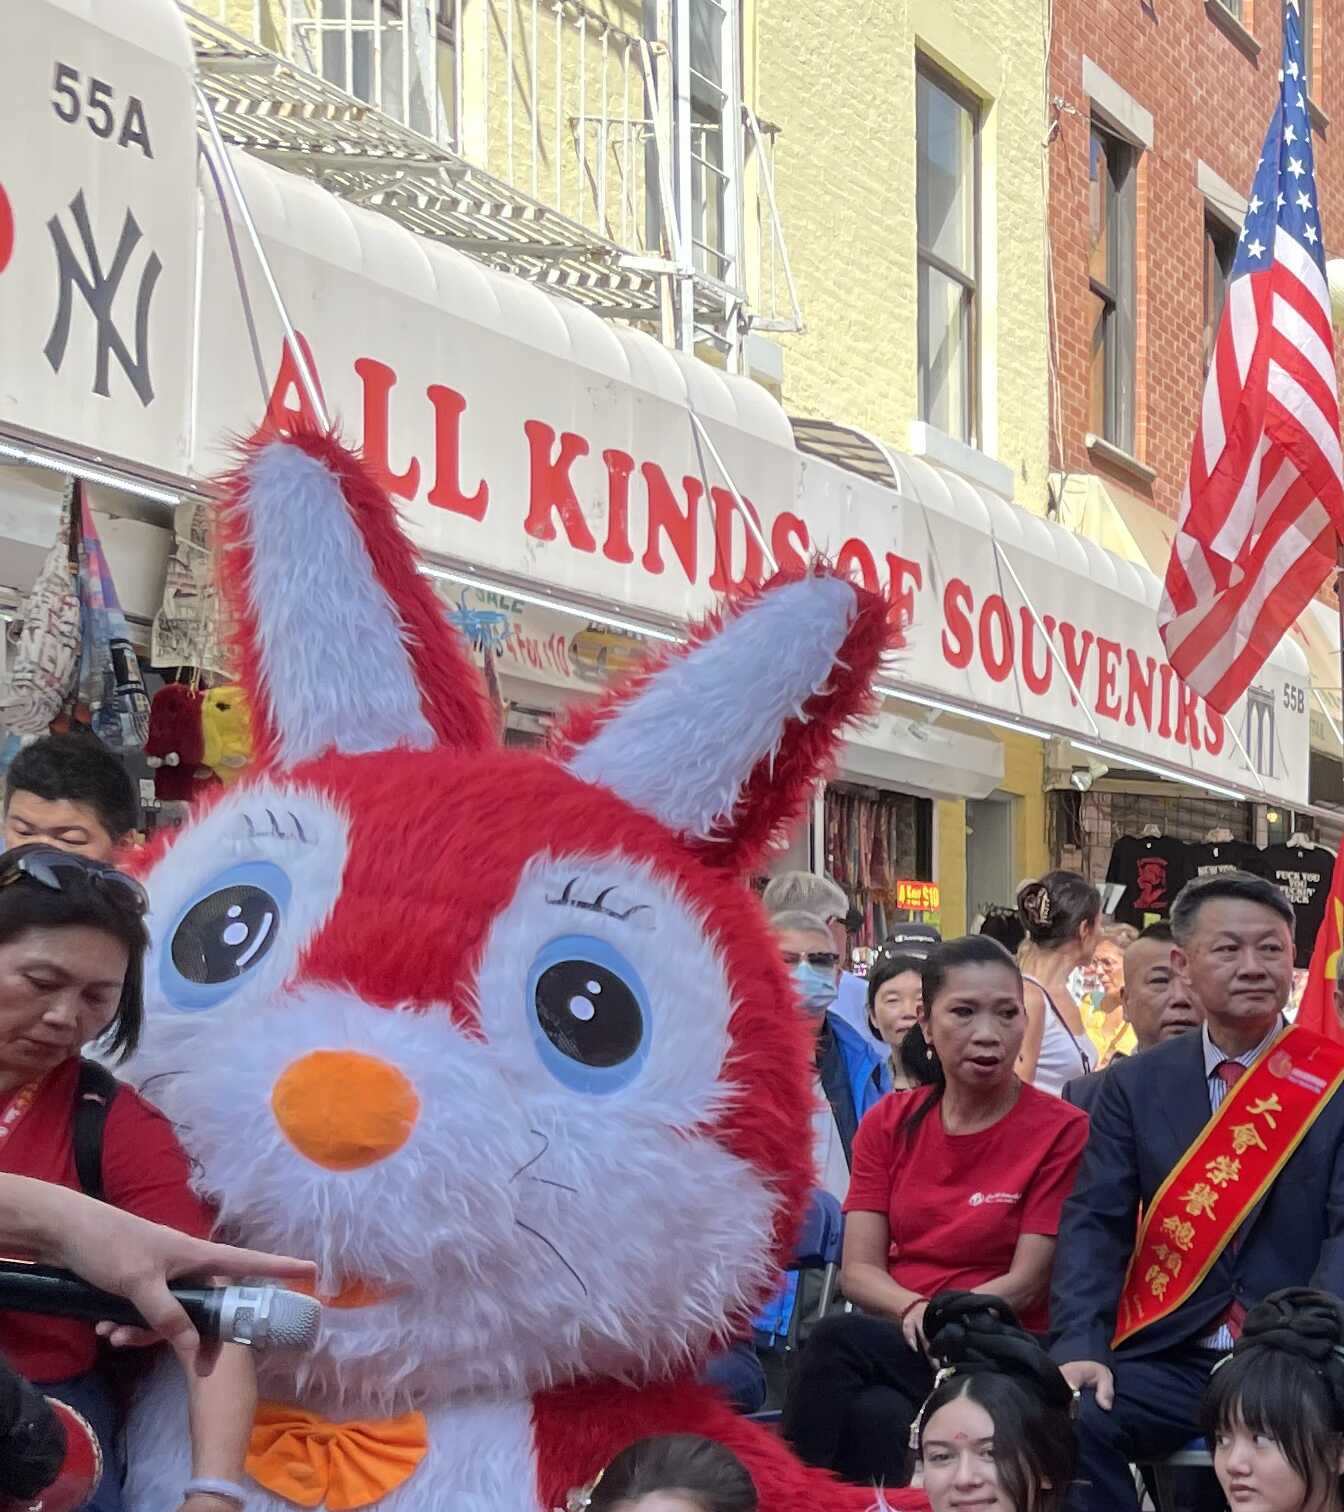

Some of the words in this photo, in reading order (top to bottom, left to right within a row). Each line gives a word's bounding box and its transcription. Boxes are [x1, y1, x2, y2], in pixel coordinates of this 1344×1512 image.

[52, 62, 154, 159] 55A
[43, 186, 163, 408] NY
[249, 330, 489, 522] ALL
[524, 419, 810, 597] KINDS
[1283, 682, 1305, 714] 55B
